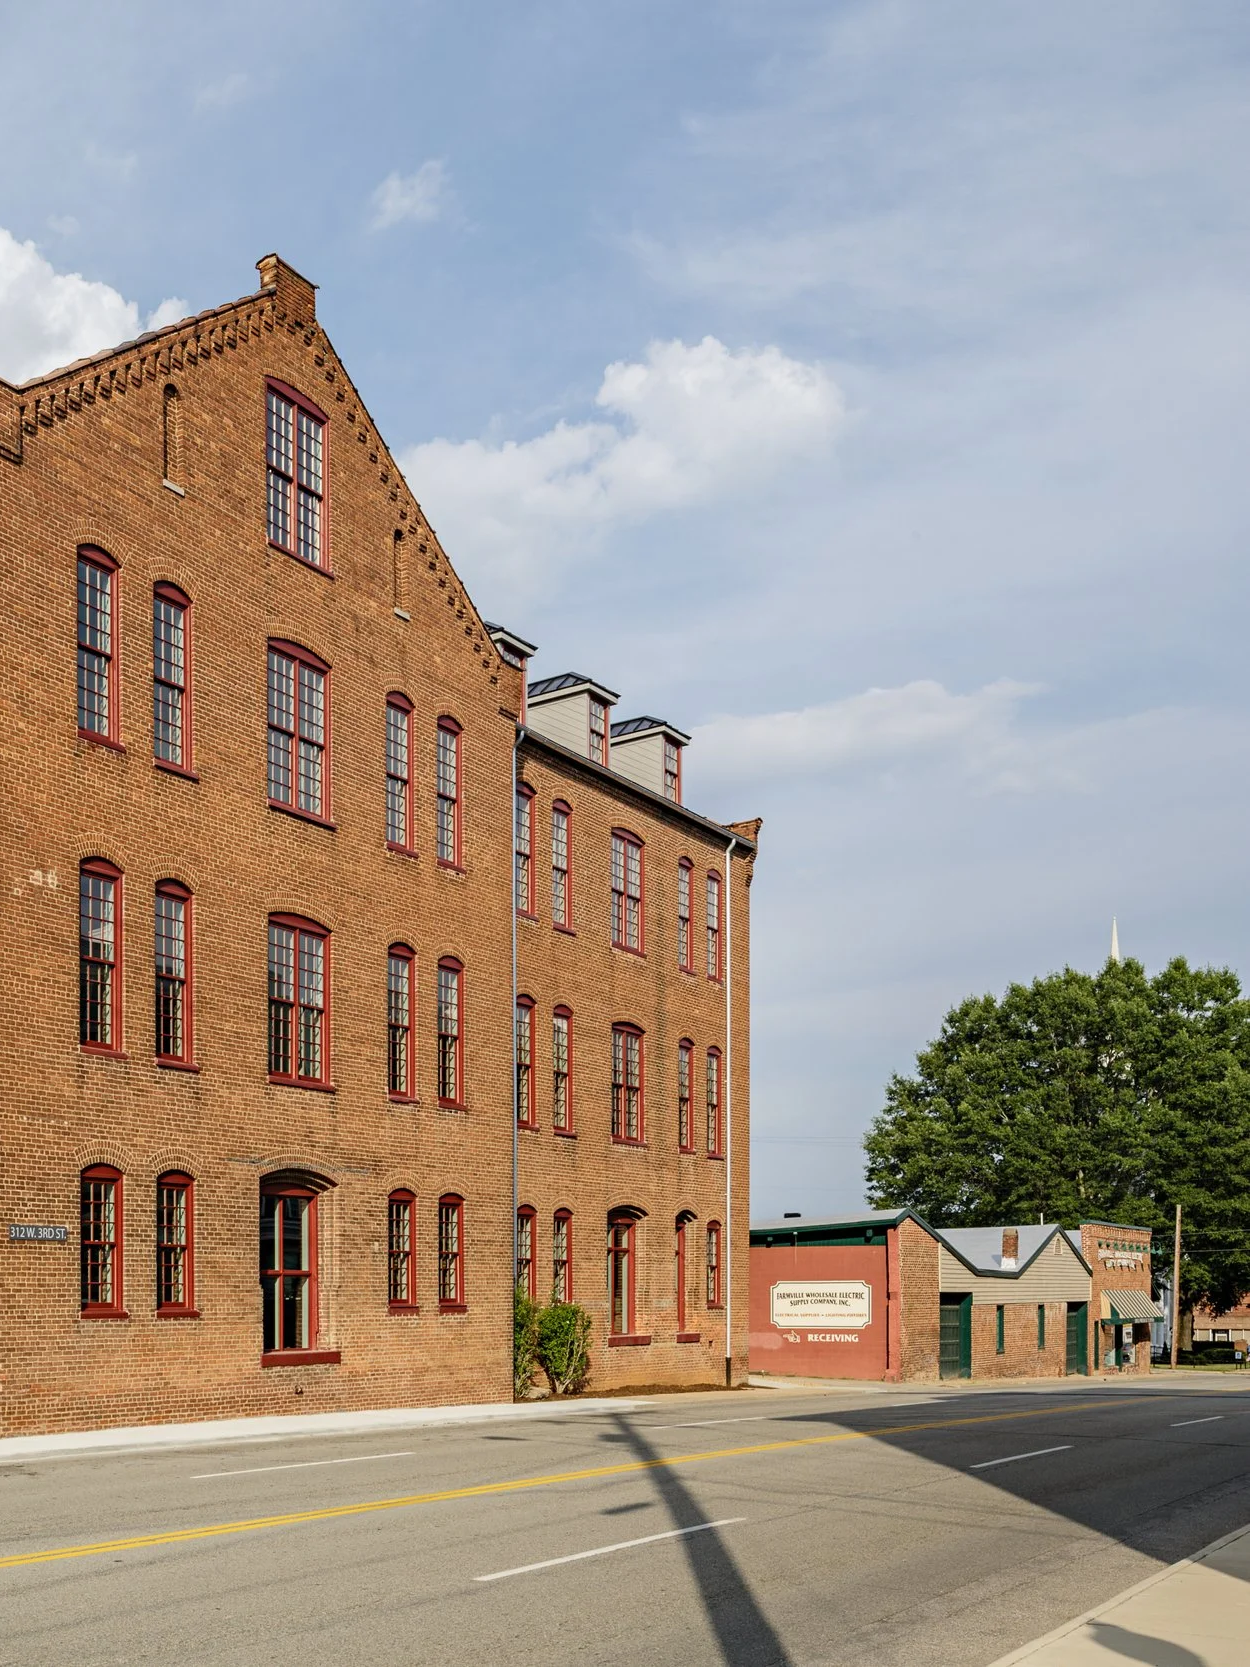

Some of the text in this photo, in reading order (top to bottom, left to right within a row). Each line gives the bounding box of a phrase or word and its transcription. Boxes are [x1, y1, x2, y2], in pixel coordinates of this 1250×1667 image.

[10, 1226, 67, 1239] 312 W. 3RD ST.
[776, 1292, 804, 1300] FARMVILLE
[839, 1292, 865, 1300] ELECTRIC
[790, 1299, 809, 1307] SUPPLY
[807, 1333, 859, 1343] RECEIVING
